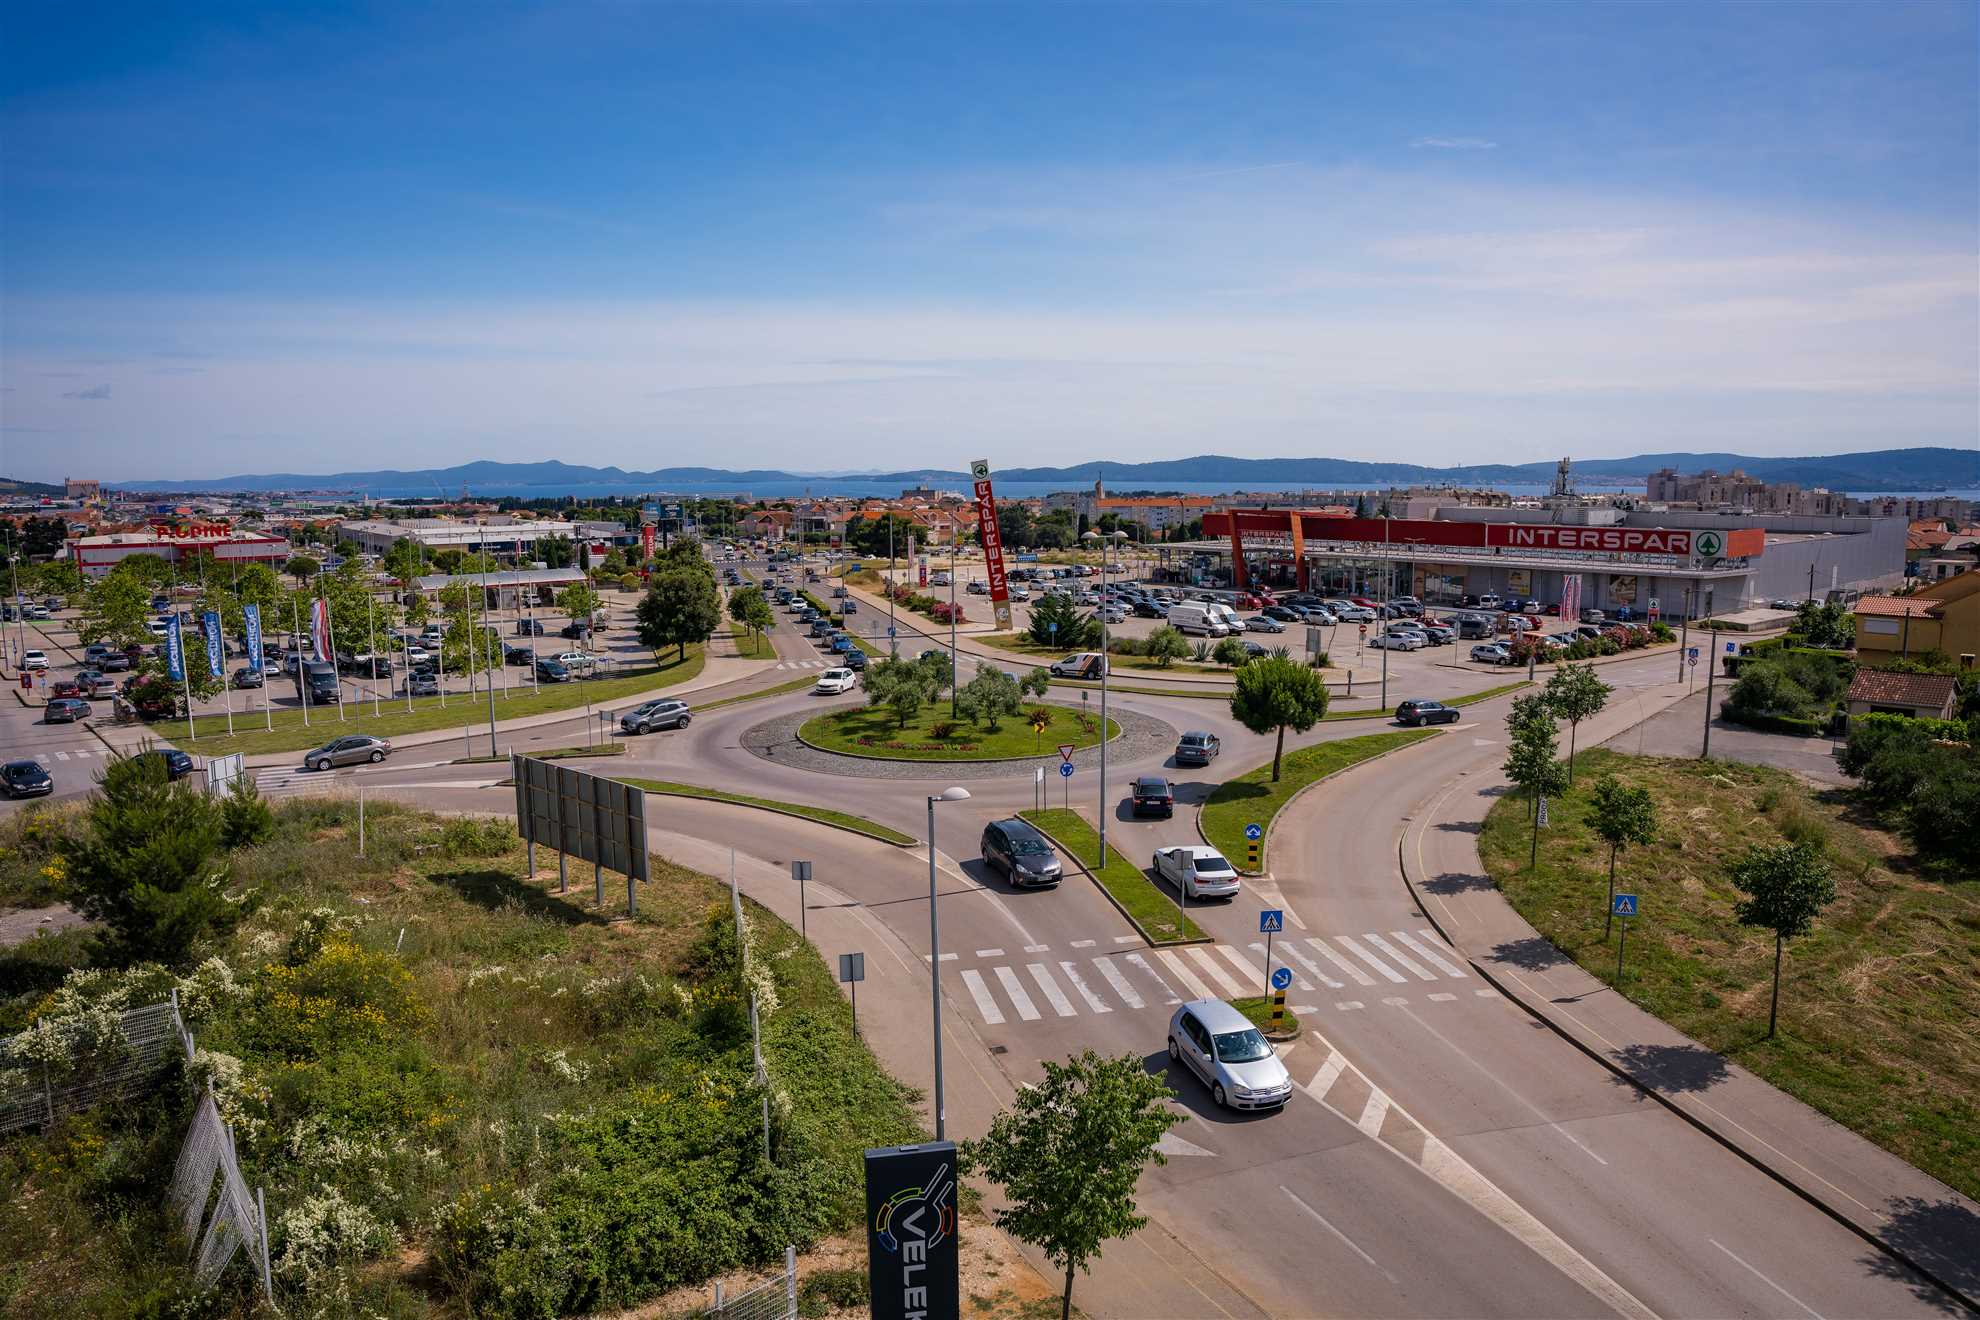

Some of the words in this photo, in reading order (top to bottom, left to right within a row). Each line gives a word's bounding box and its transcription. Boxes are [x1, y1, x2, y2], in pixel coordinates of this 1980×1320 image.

[156, 525, 231, 539] PLODINE
[978, 481, 1004, 591] INTERSPAR
[1508, 528, 1689, 551] INTERSPAR
[168, 622, 180, 672] DECATHLON
